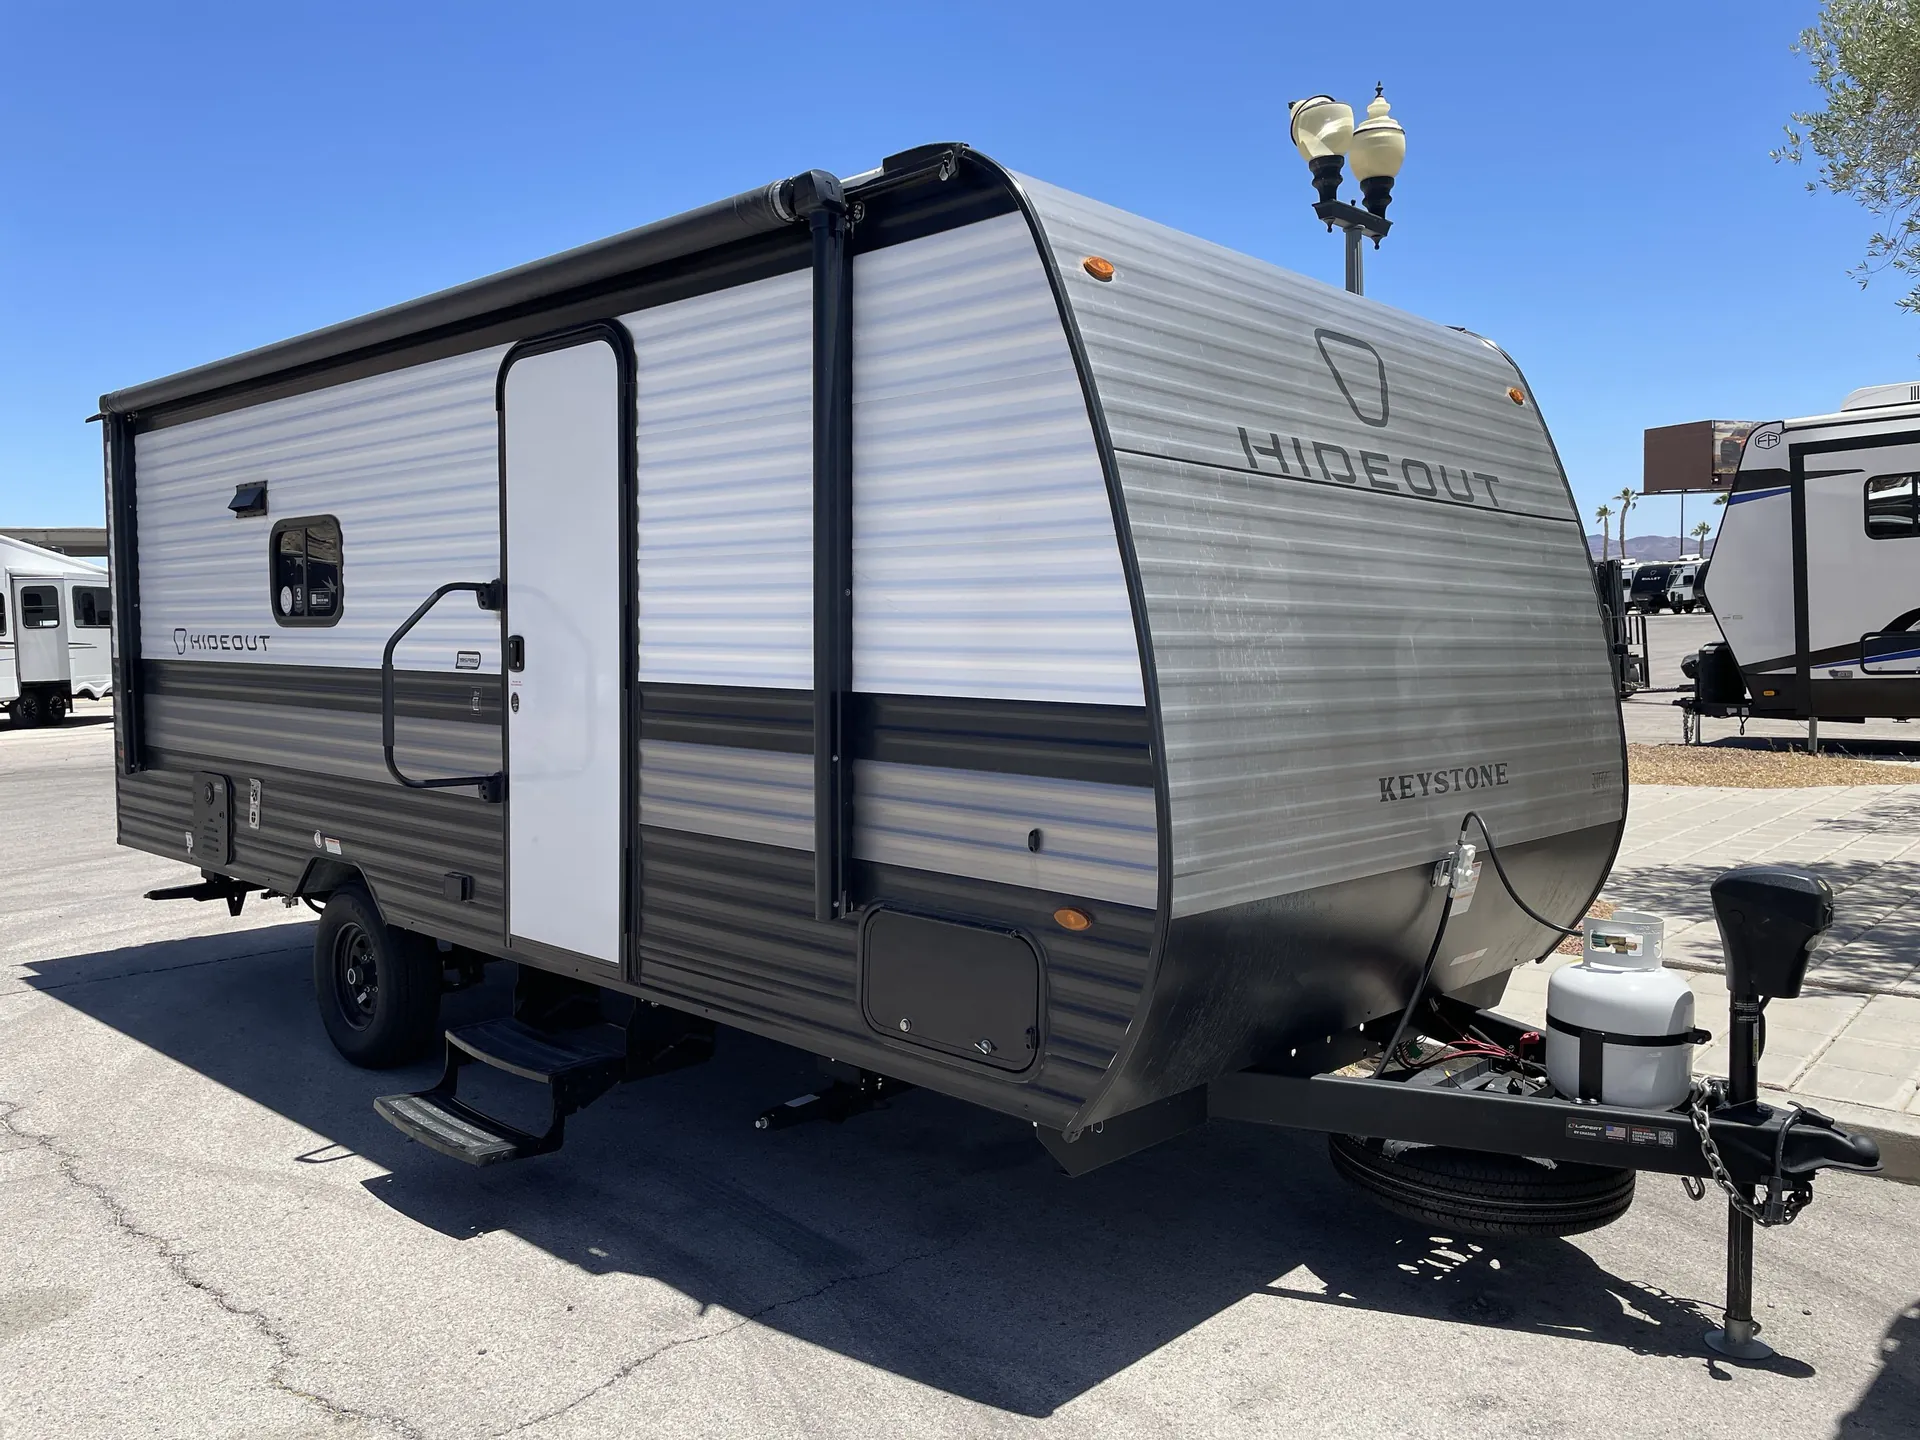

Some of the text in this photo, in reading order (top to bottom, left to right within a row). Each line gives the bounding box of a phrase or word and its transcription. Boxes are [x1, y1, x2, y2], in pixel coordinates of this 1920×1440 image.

[1237, 426, 1500, 507] HIDEOUT
[296, 587, 302, 601] 3
[190, 634, 270, 651] HIDEOUT
[1379, 762, 1509, 802] KEYSTONE
